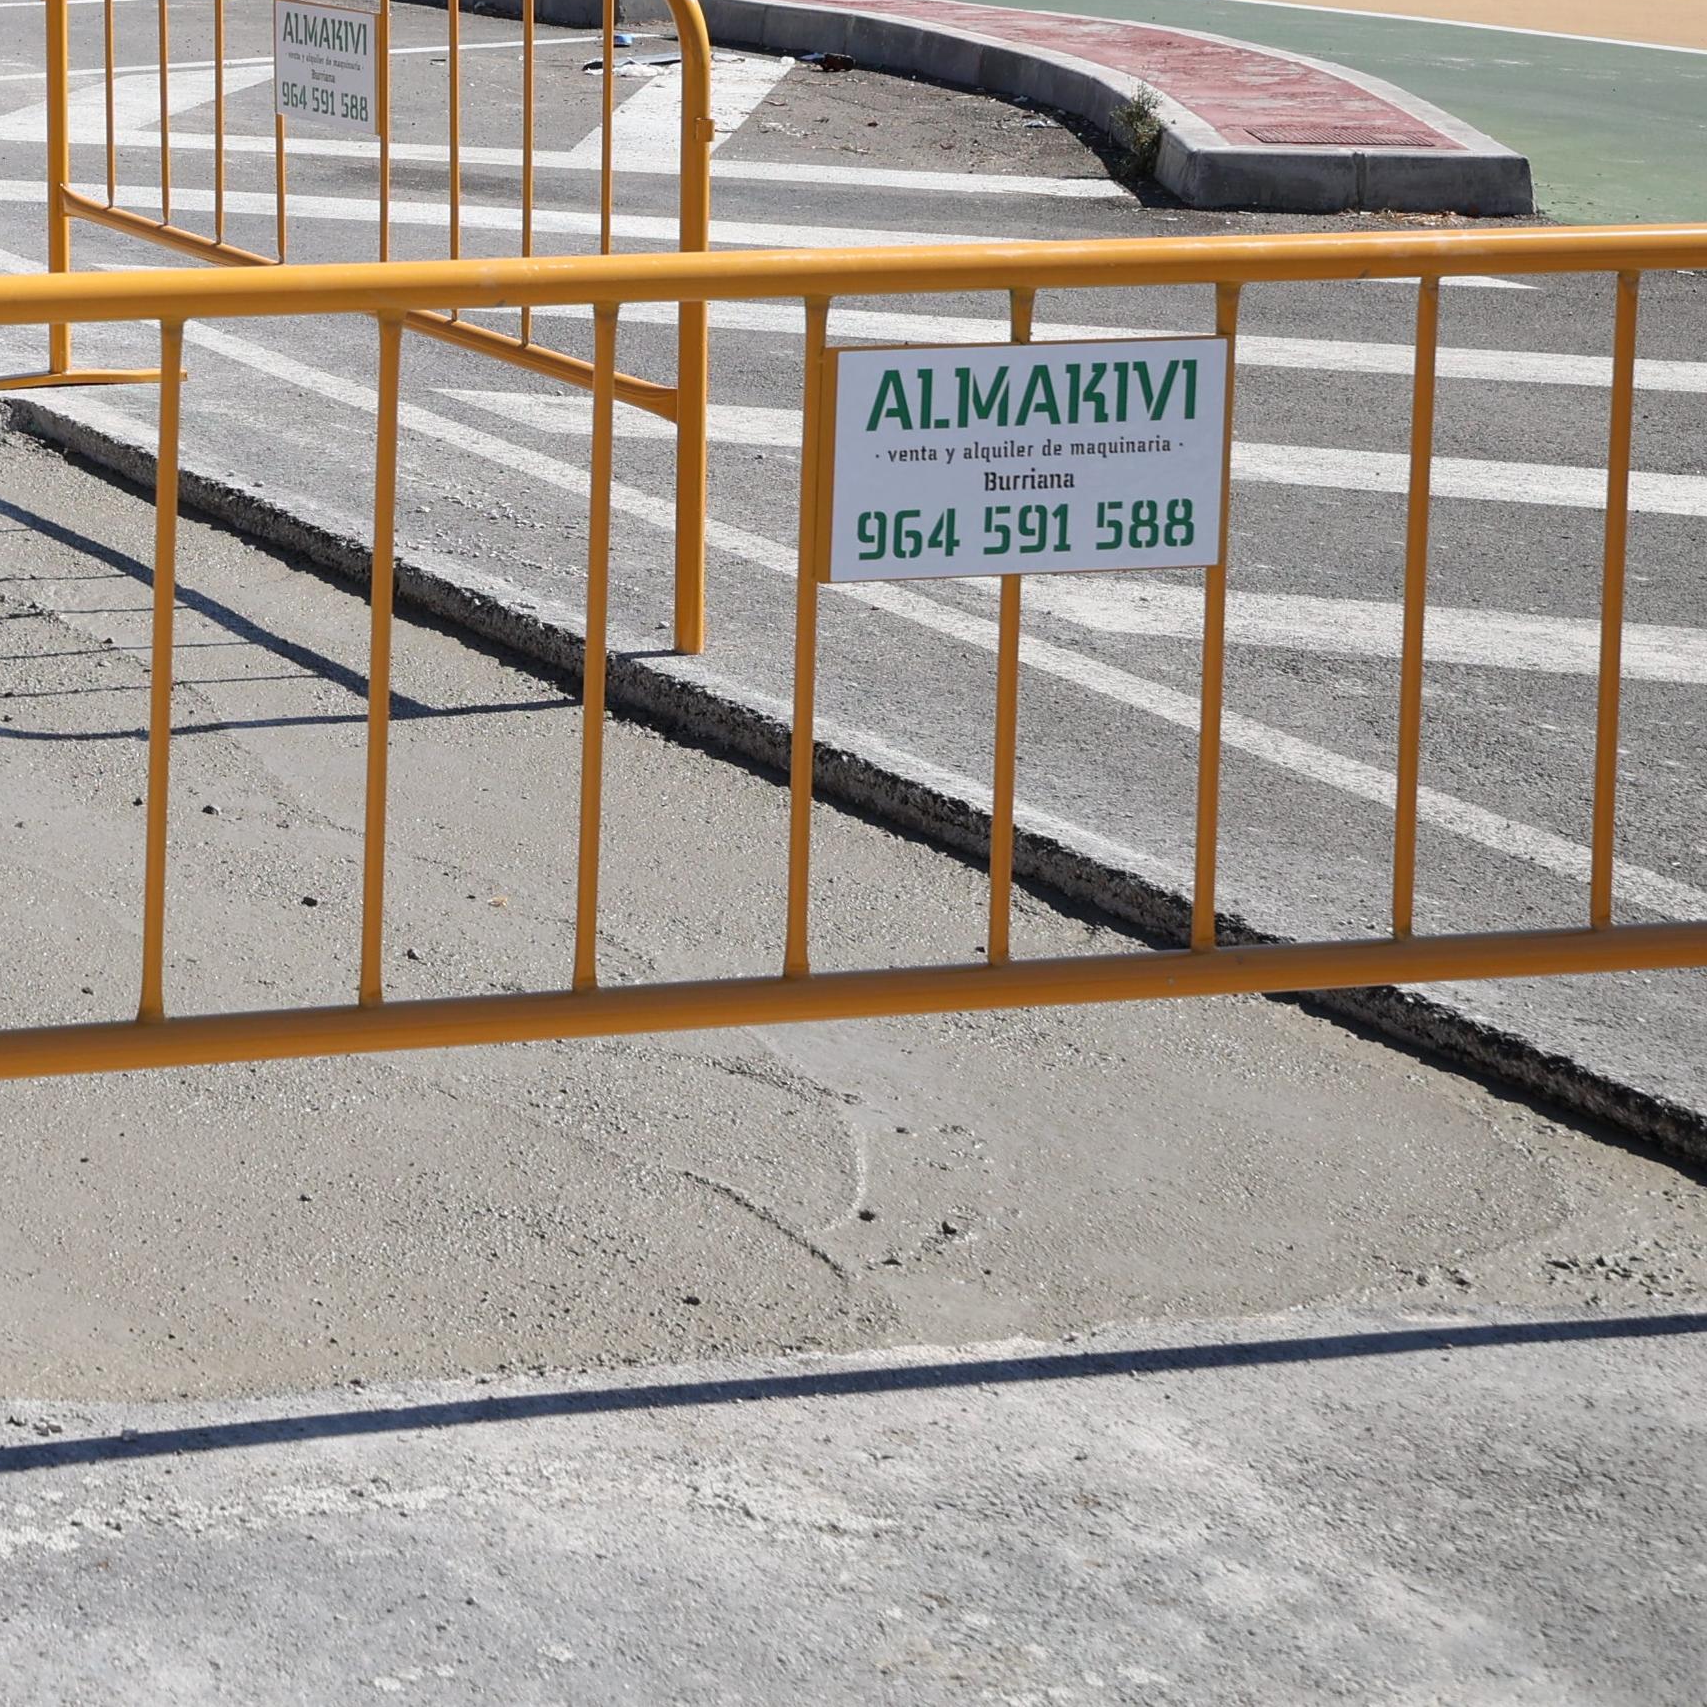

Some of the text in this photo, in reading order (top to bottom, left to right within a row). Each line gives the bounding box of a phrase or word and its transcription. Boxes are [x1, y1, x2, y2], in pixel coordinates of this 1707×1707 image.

[282, 11, 367, 56] ALMAKIVI
[306, 53, 325, 65] alquiler
[333, 58, 361, 71] maquinaria
[311, 69, 335, 83] Burriana
[282, 81, 368, 122] 964 591 588
[865, 359, 1198, 432] ALMAKIVI
[888, 435, 1172, 464] venta y alquiler de maquinaria
[984, 467, 1075, 491] Burriana
[857, 498, 1194, 560] 964 591 588
